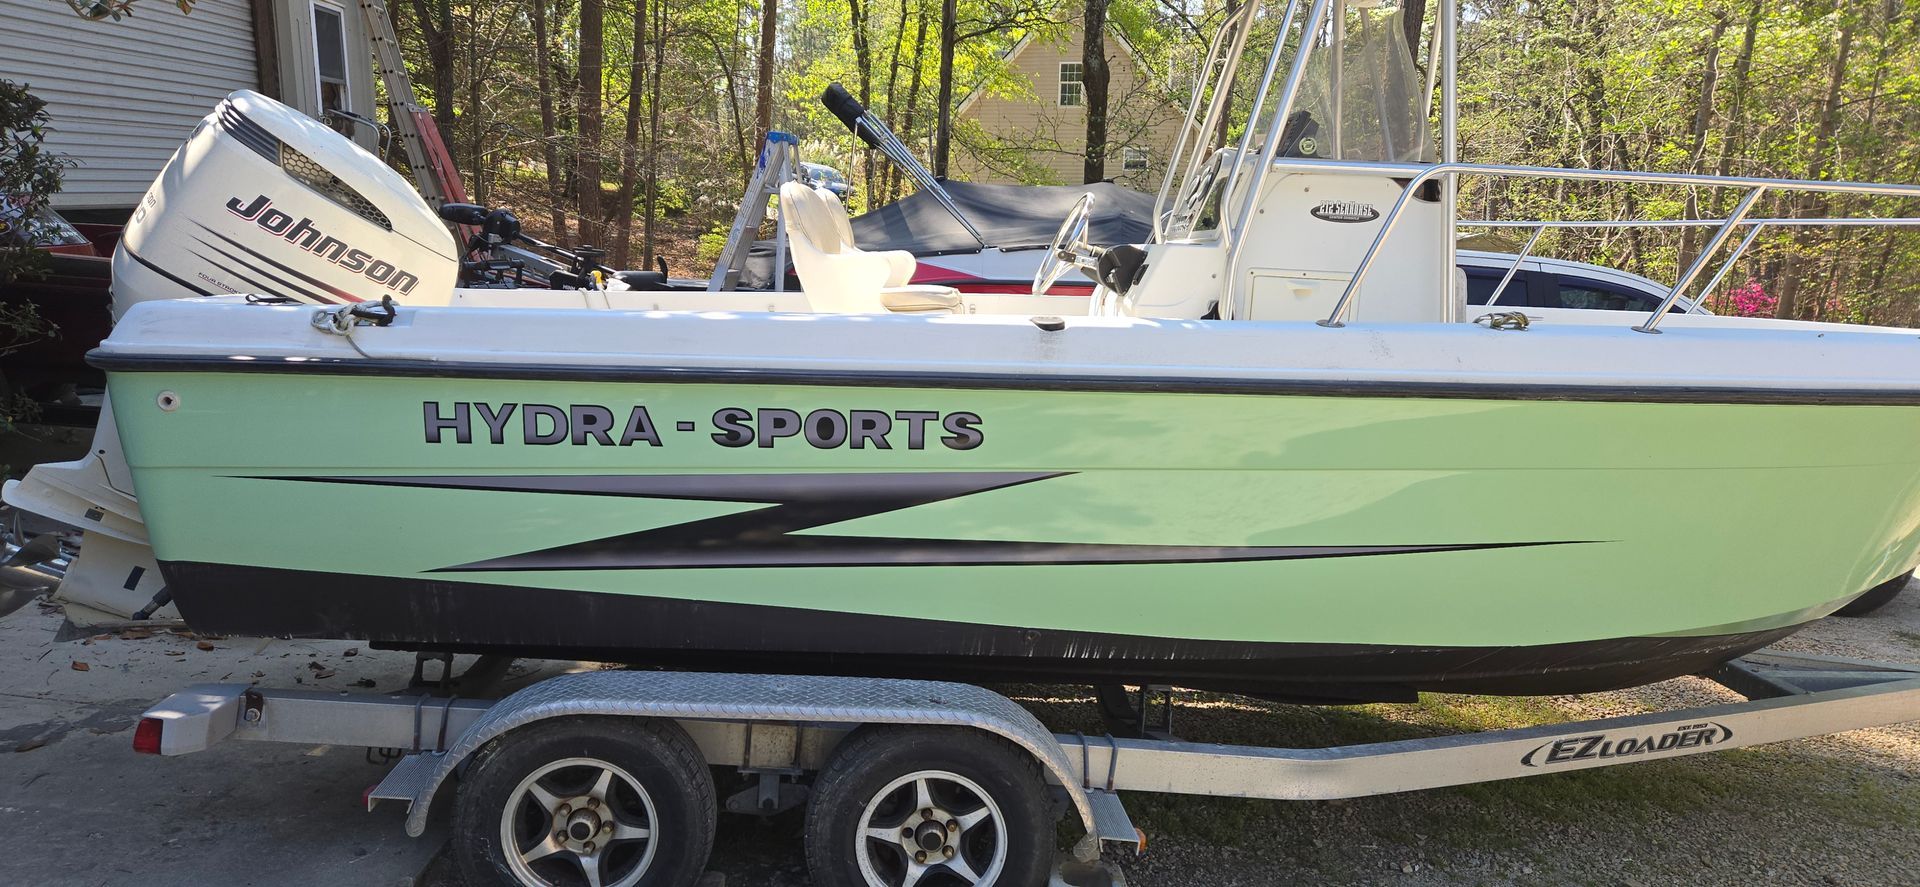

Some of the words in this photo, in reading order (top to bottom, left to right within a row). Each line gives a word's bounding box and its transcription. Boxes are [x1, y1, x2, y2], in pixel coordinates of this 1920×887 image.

[1319, 199, 1334, 214] 212
[225, 194, 420, 296] Johnson
[423, 401, 664, 447] HYDRA
[710, 407, 985, 451] SPORTS
